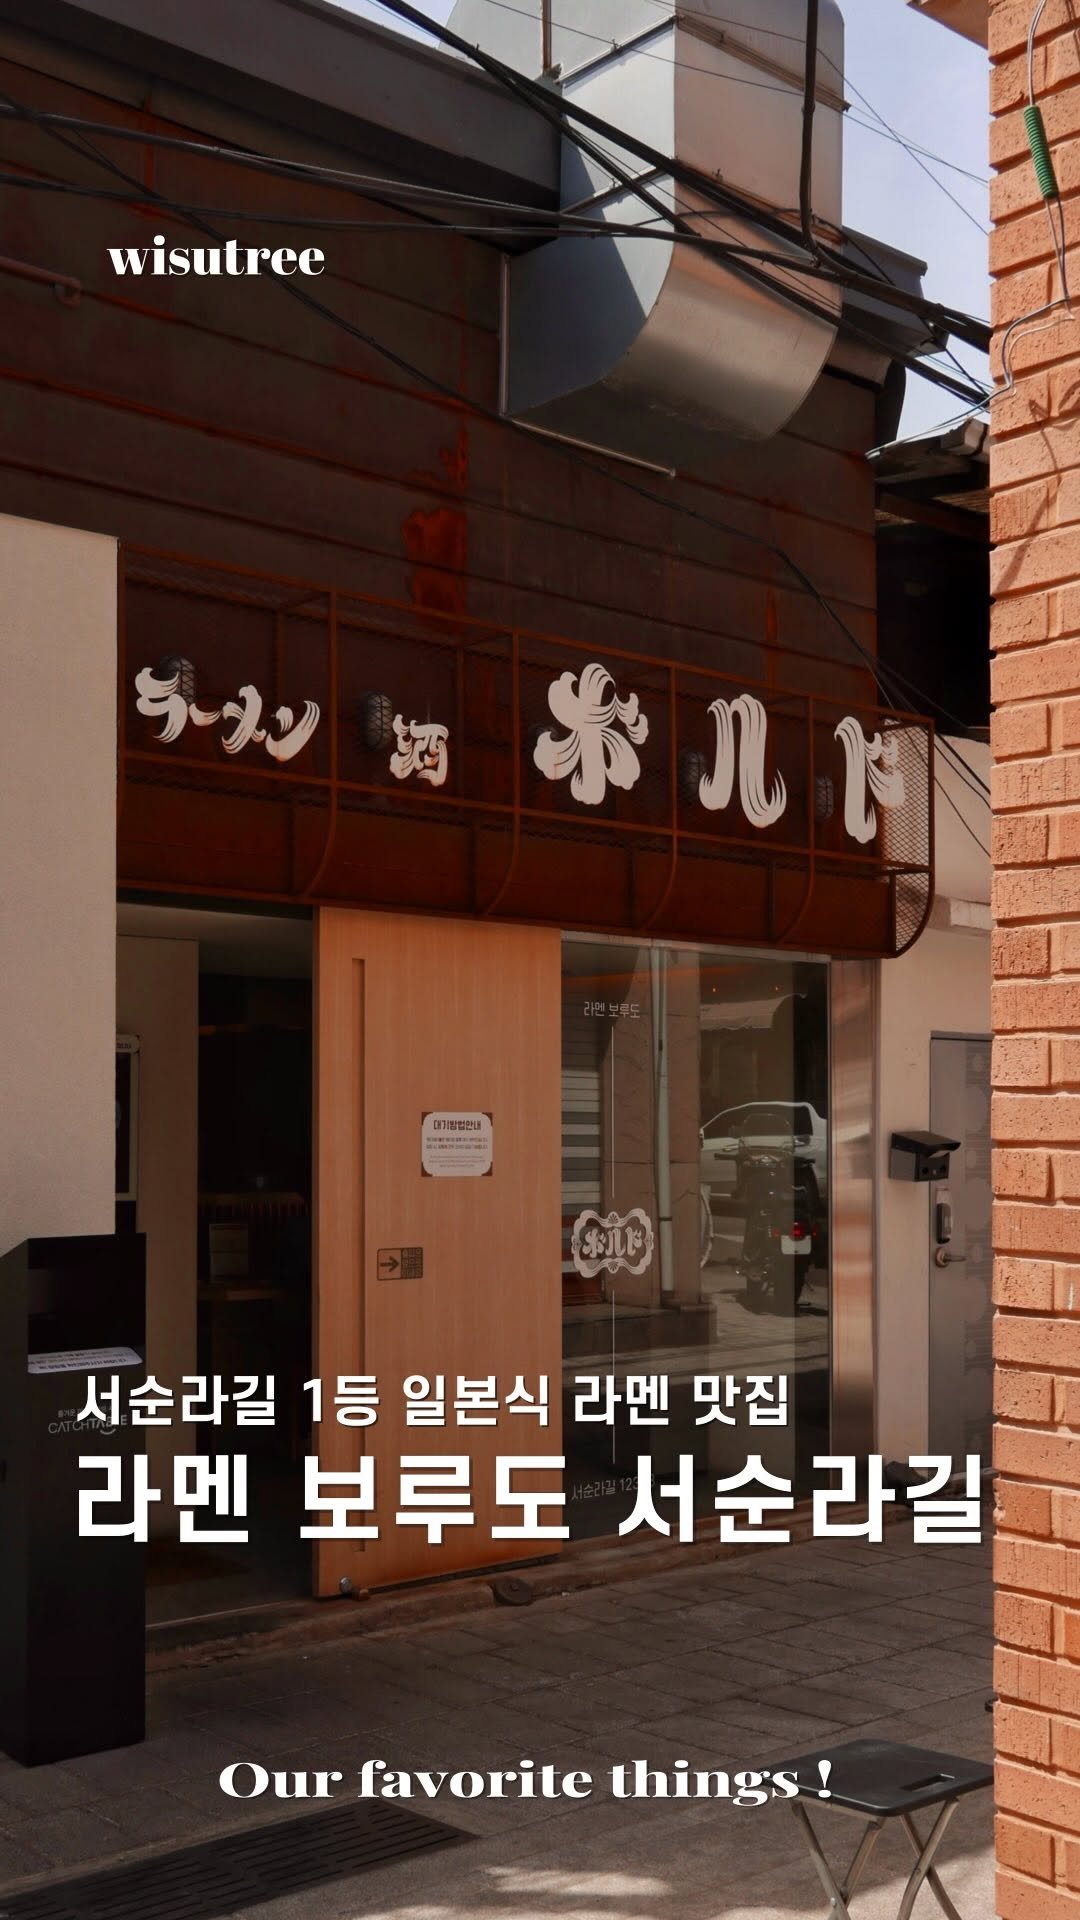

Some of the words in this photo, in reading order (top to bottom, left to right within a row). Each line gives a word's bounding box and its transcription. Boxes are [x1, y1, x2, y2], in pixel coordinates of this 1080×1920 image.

[135, 666, 320, 762] ラーメン
[389, 713, 449, 787] 酒
[583, 1001, 605, 1017] 라멘
[608, 1002, 641, 1019] 보루도
[433, 1119, 482, 1131] 대기방법안내
[571, 1479, 616, 1501] 서순라길
